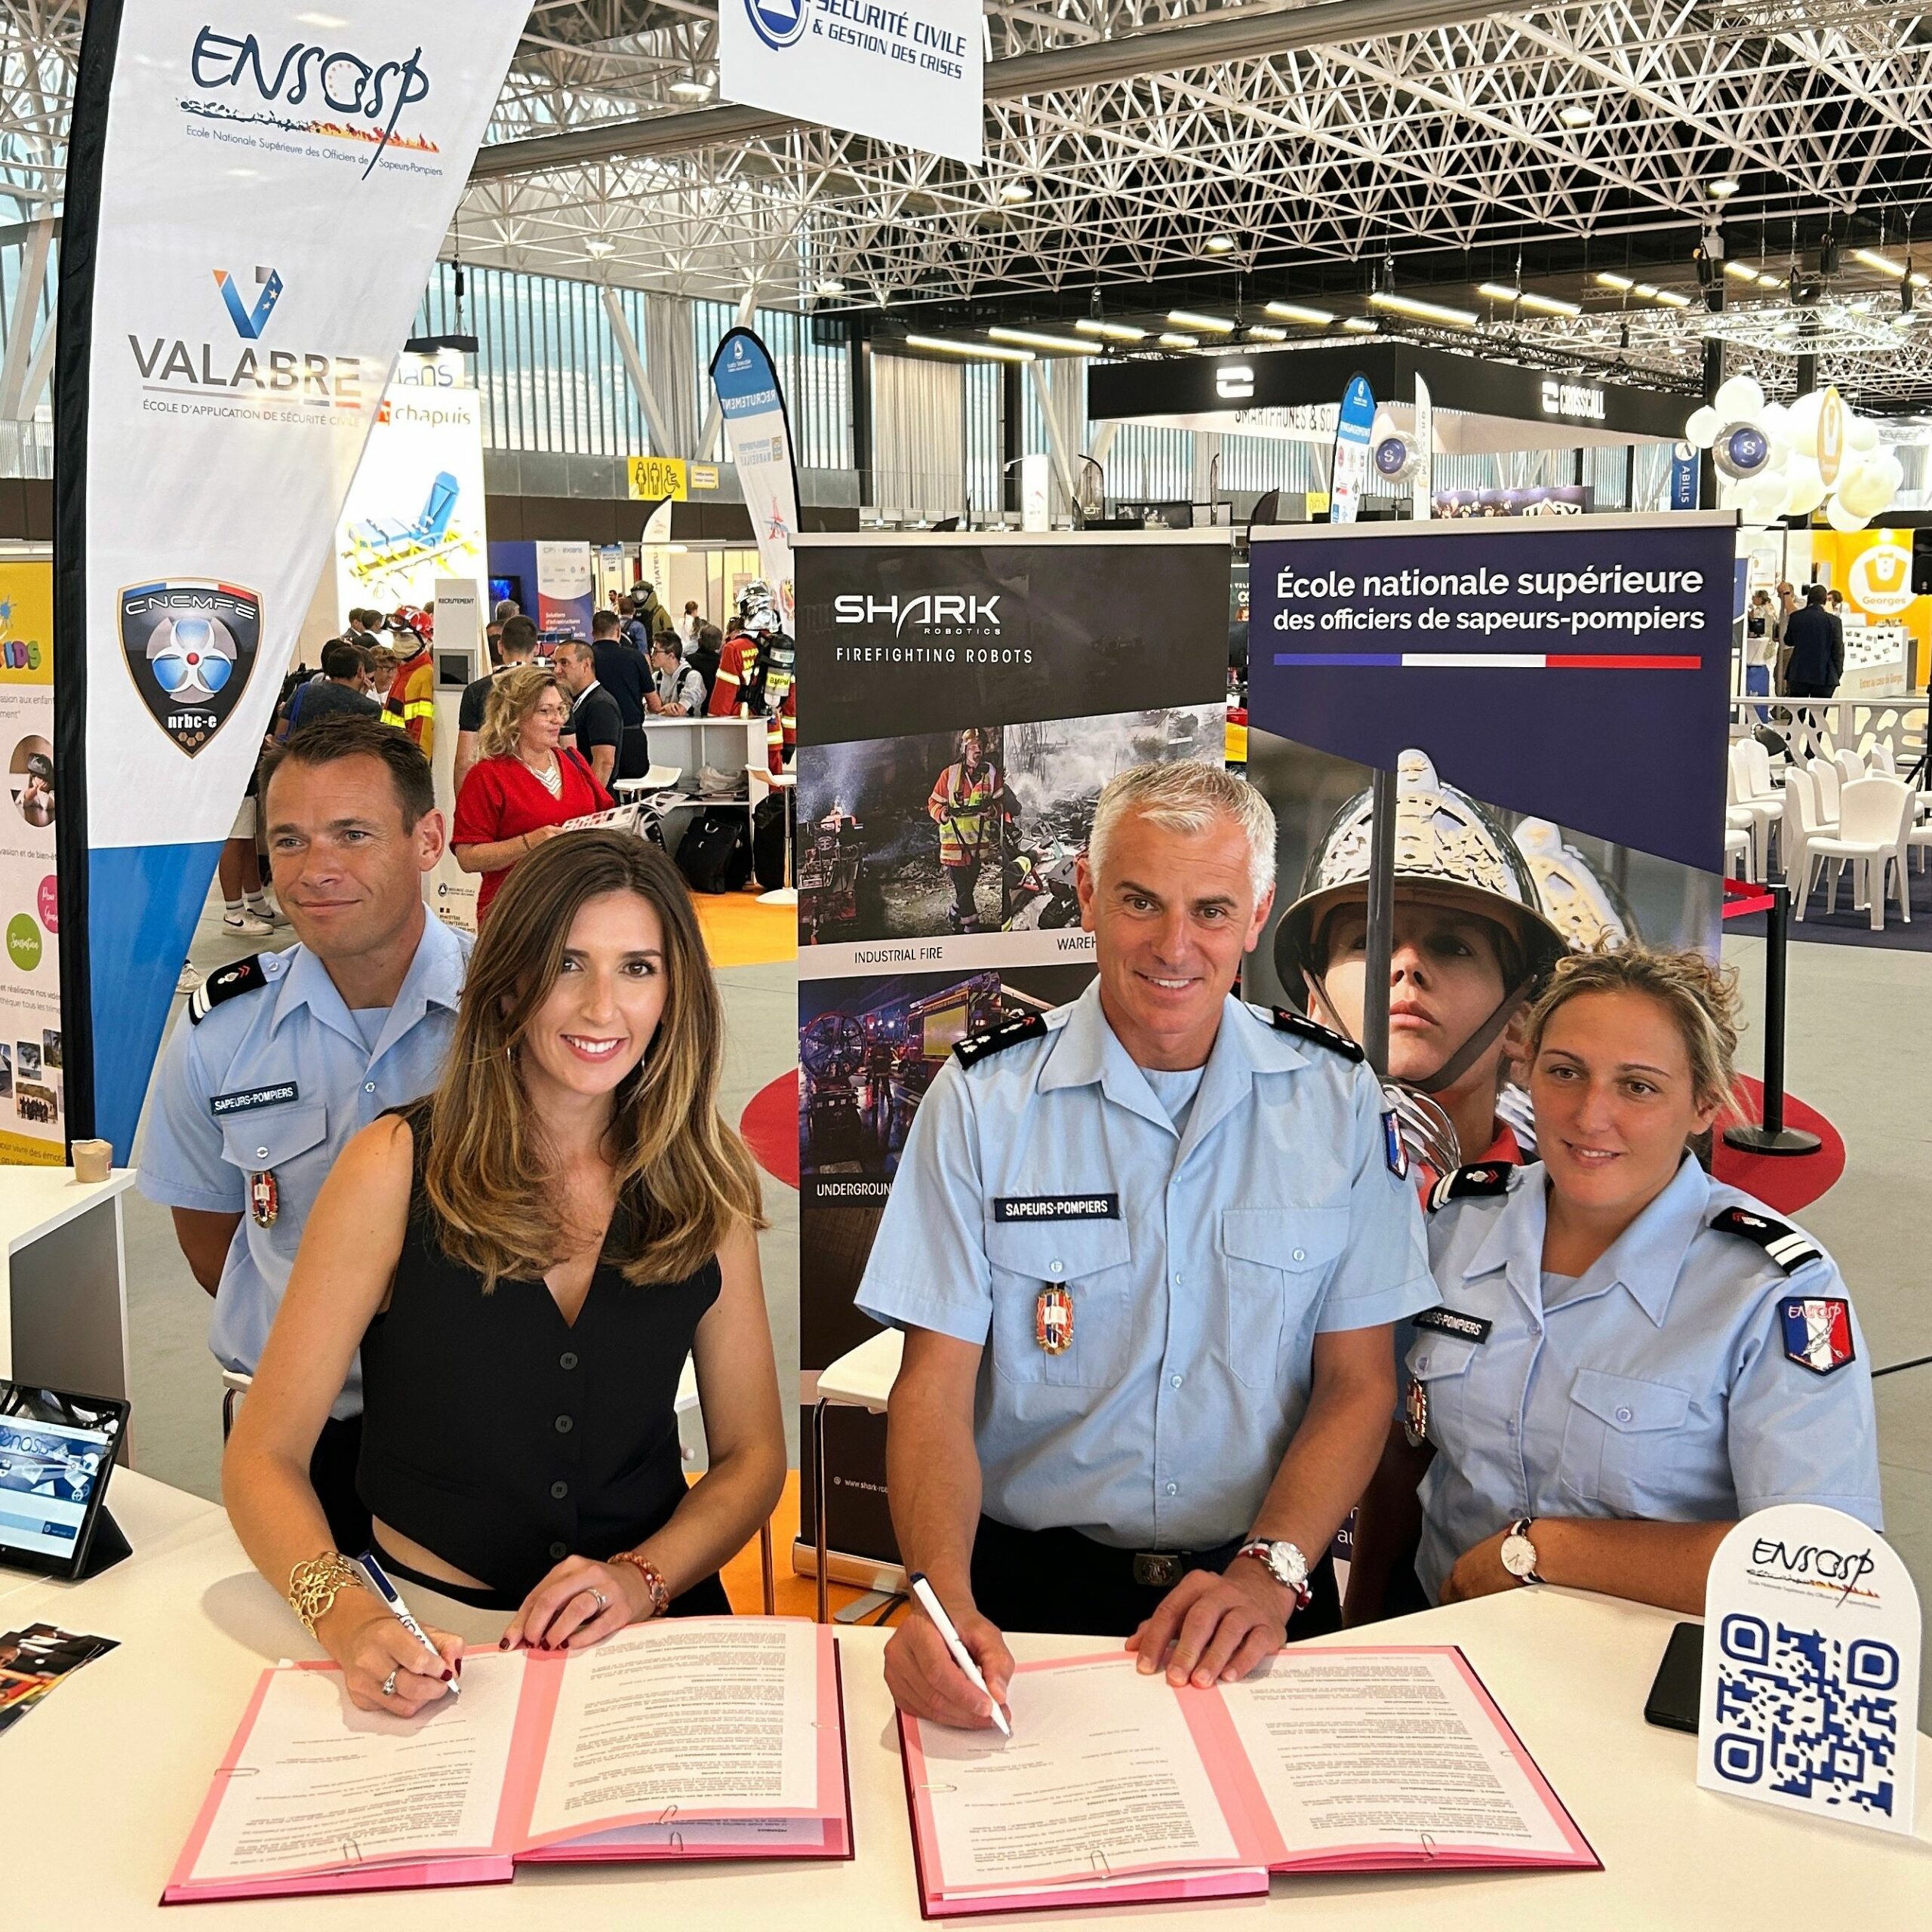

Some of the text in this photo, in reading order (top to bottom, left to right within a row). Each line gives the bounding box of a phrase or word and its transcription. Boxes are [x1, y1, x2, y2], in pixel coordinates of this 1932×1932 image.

[812, 19, 963, 79] & GESTION DES CRISES
[914, 22, 967, 57] CIVILE
[187, 125, 443, 177] Ecole Nationale Supérieure des Officiers de Sapeurs-Pompiers
[128, 334, 361, 397] VALABRE
[143, 399, 179, 414] ÉCOLE
[181, 403, 260, 420] D'APPLICATION
[263, 411, 278, 421] DE
[280, 410, 327, 425] SÉCURITÉ
[1560, 385, 1605, 419] CROSSCALL
[395, 405, 471, 428] chapuis
[1384, 450, 1395, 462] S
[1743, 441, 1755, 455] S
[1681, 466, 1690, 503] ABILIS
[1276, 564, 1704, 602] École nationale supérieure
[1863, 596, 1906, 605] Georges
[834, 595, 1001, 639] SHARK
[1273, 605, 1705, 635] des officiers de sapeurs-pompiers
[836, 648, 1033, 663] FIREFIGHTING ROBOTS
[33, 694, 54, 705] enfan
[168, 712, 217, 730] nrbc-e
[27, 850, 35, 858] de
[854, 946, 943, 964] INDUSTRIAL FIRE
[215, 1087, 294, 1111] SAPEURS-POMPIERS
[1005, 1200, 1108, 1216] SAPEURS-POMPIERS
